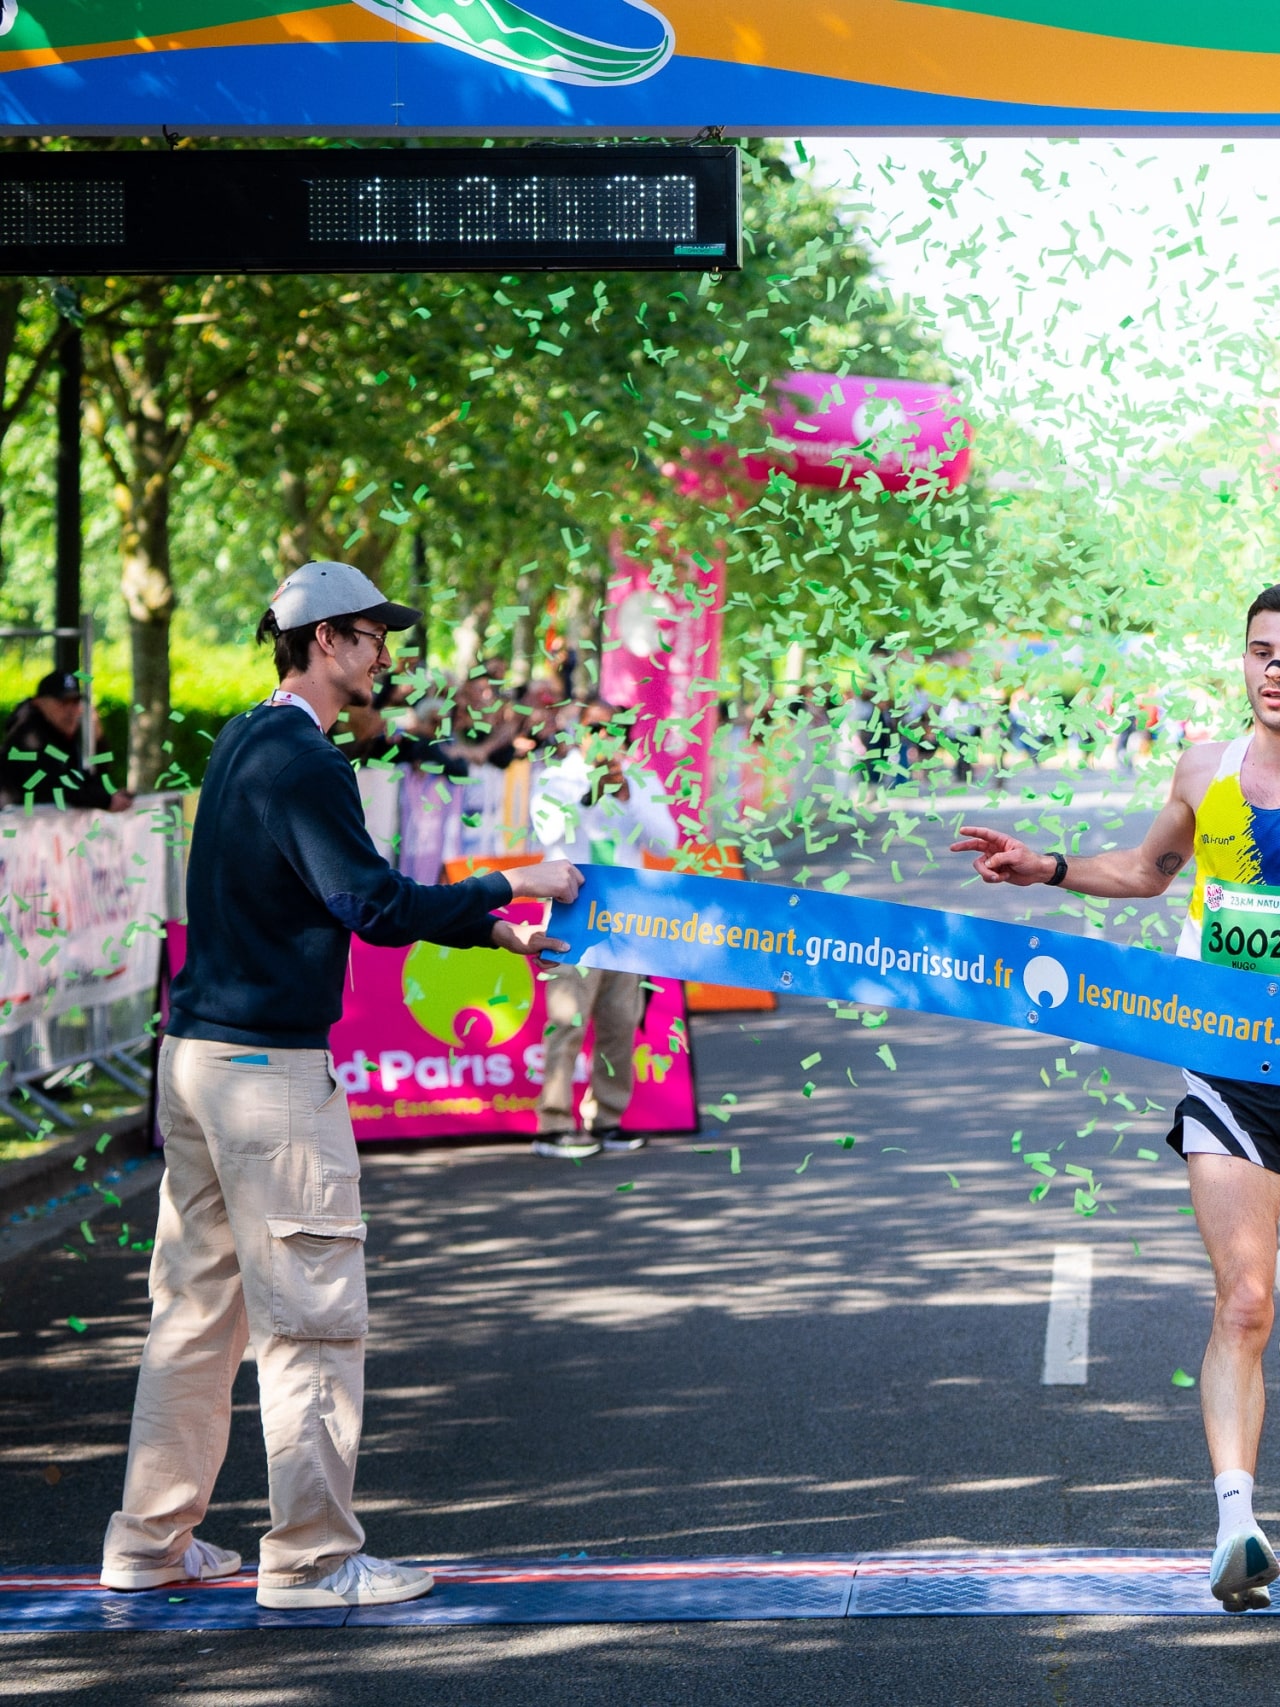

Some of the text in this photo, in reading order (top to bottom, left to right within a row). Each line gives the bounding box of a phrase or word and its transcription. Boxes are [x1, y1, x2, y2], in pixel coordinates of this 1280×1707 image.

[359, 176, 695, 241] 1:24:30
[587, 901, 1014, 988] lesrunsdesenart.grandparissud.fr
[1231, 960, 1257, 971] HUGO
[378, 1049, 514, 1092] Paris
[1222, 1489, 1240, 1500] RUN
